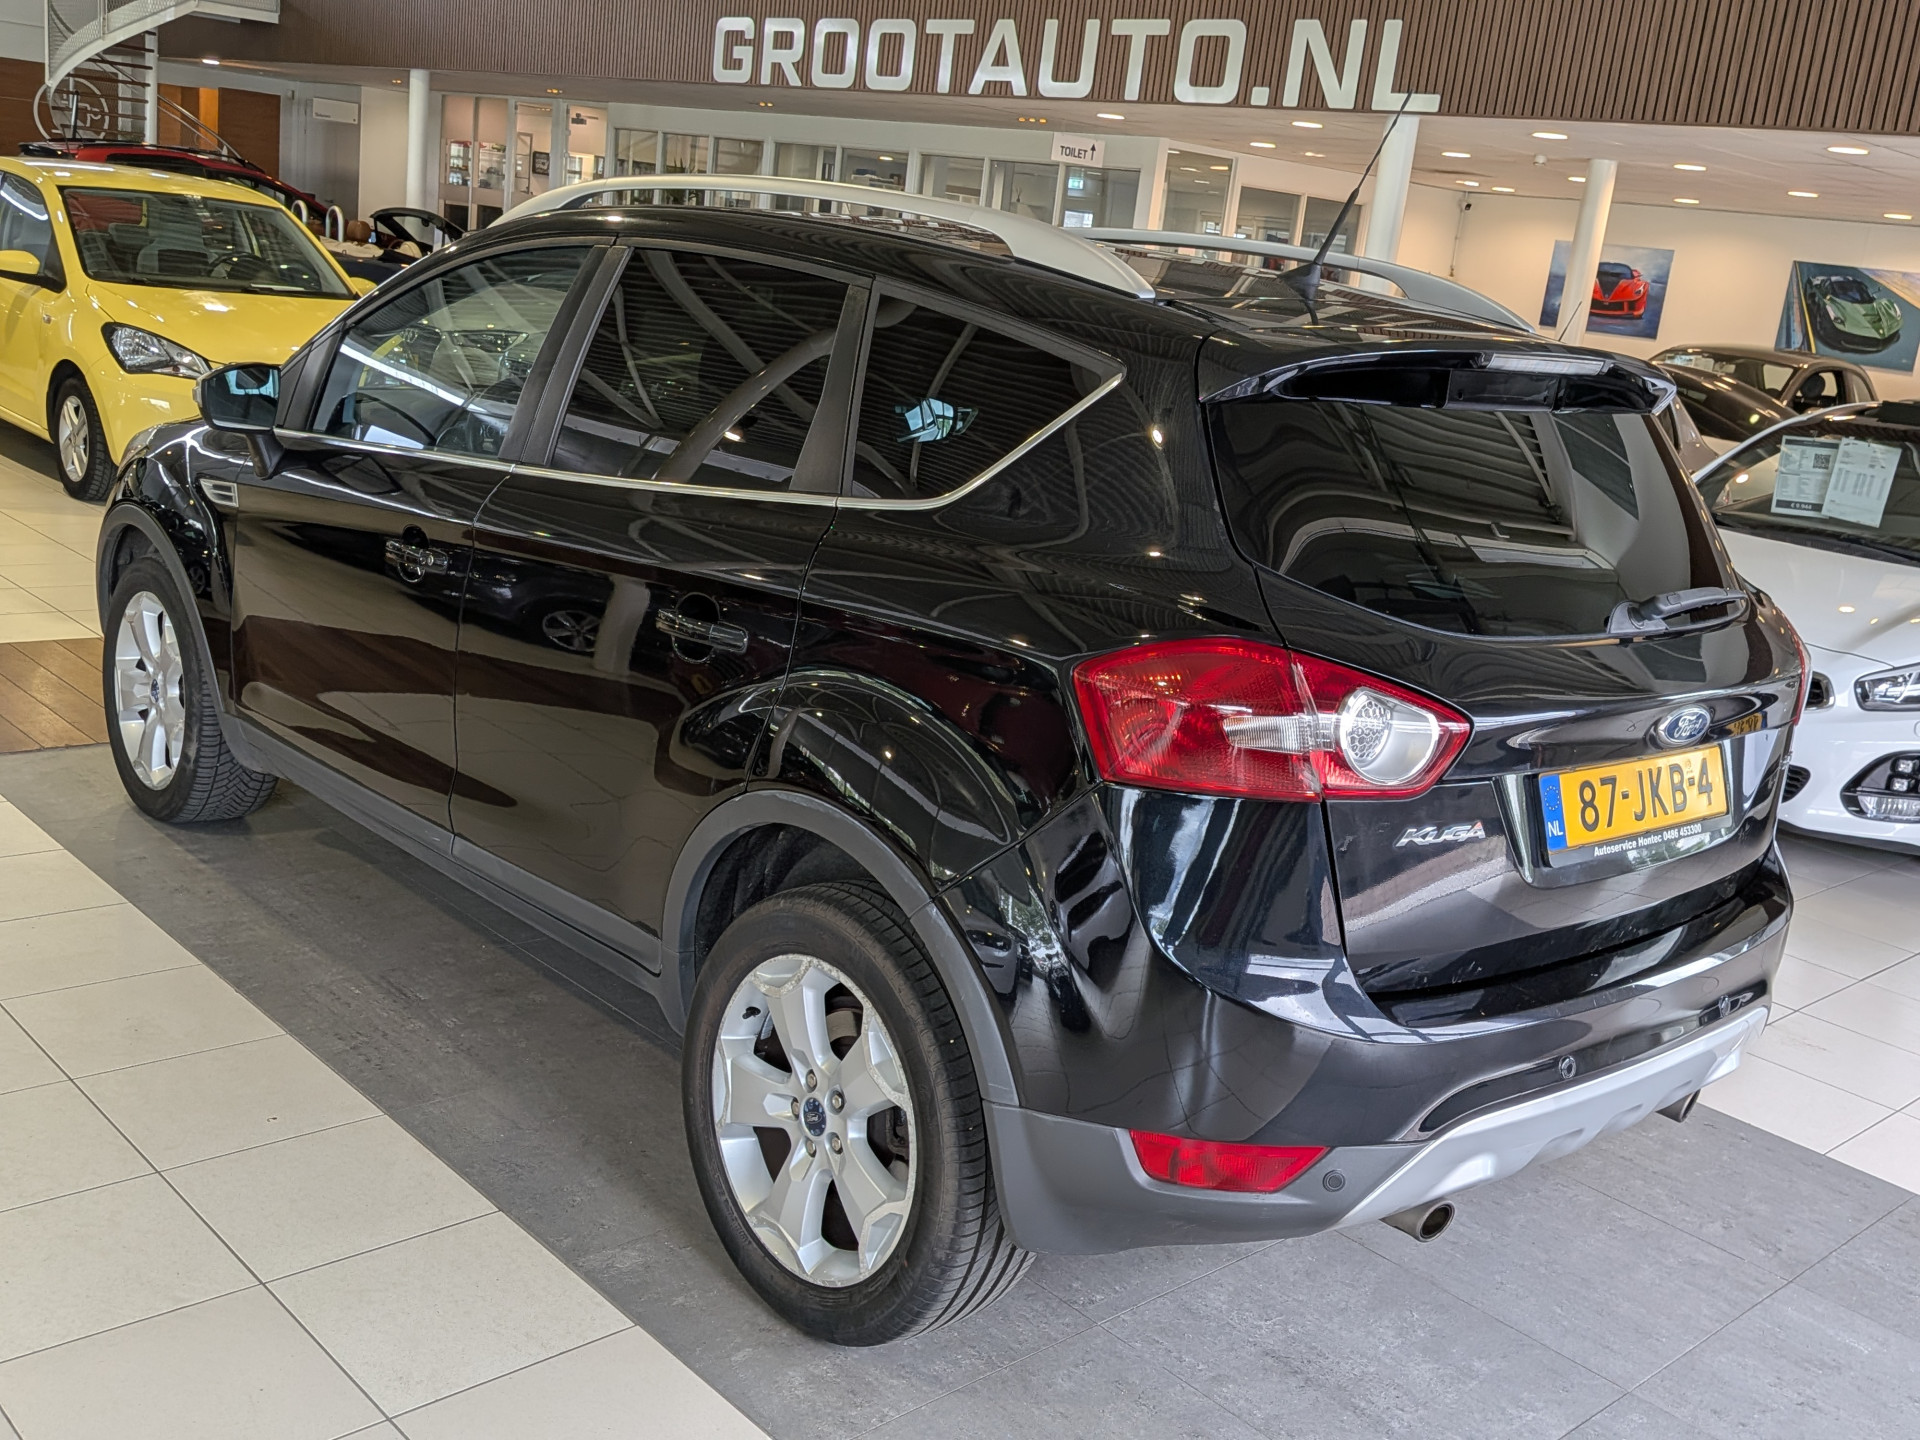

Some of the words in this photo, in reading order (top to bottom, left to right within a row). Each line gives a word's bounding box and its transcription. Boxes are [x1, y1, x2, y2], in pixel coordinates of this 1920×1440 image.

[713, 16, 1441, 113] GROOTAUTO.NL
[1060, 145, 1088, 160] TOILET
[1673, 713, 1703, 739] Ford
[1578, 757, 1713, 832] 87-JKB-4
[1394, 820, 1486, 847] KUGA
[1547, 820, 1564, 837] NL
[1594, 840, 1637, 857] Autoservice
[1638, 833, 1663, 847] Hontec
[1662, 828, 1679, 841] 0486
[1679, 823, 1702, 838] 453300
